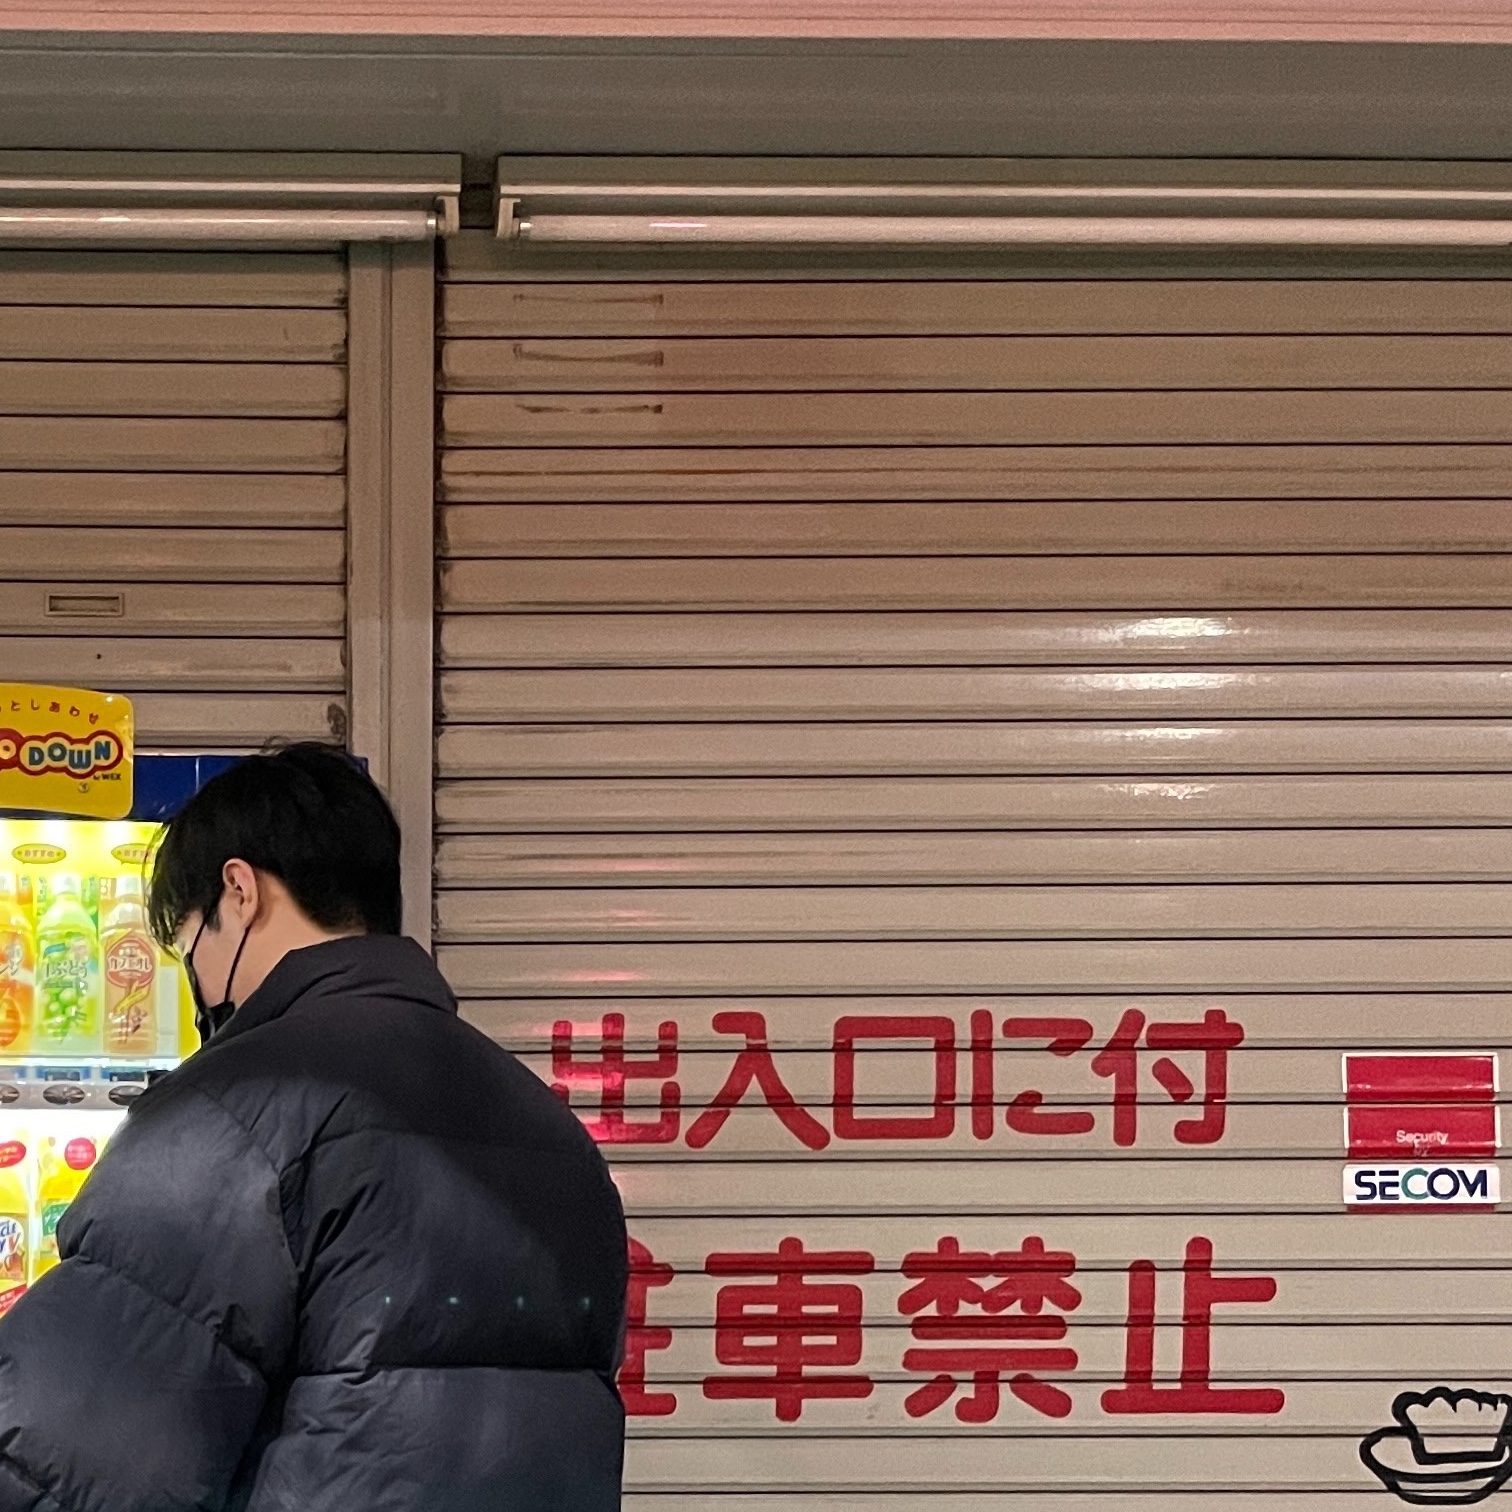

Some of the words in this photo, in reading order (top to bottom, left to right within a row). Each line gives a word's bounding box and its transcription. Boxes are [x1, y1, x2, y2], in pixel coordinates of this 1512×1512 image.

[28, 741, 112, 769] DOWN
[551, 1008, 1245, 1151] 出入口に付
[1396, 1130, 1448, 1145] Security
[1355, 1168, 1487, 1200] SECOM
